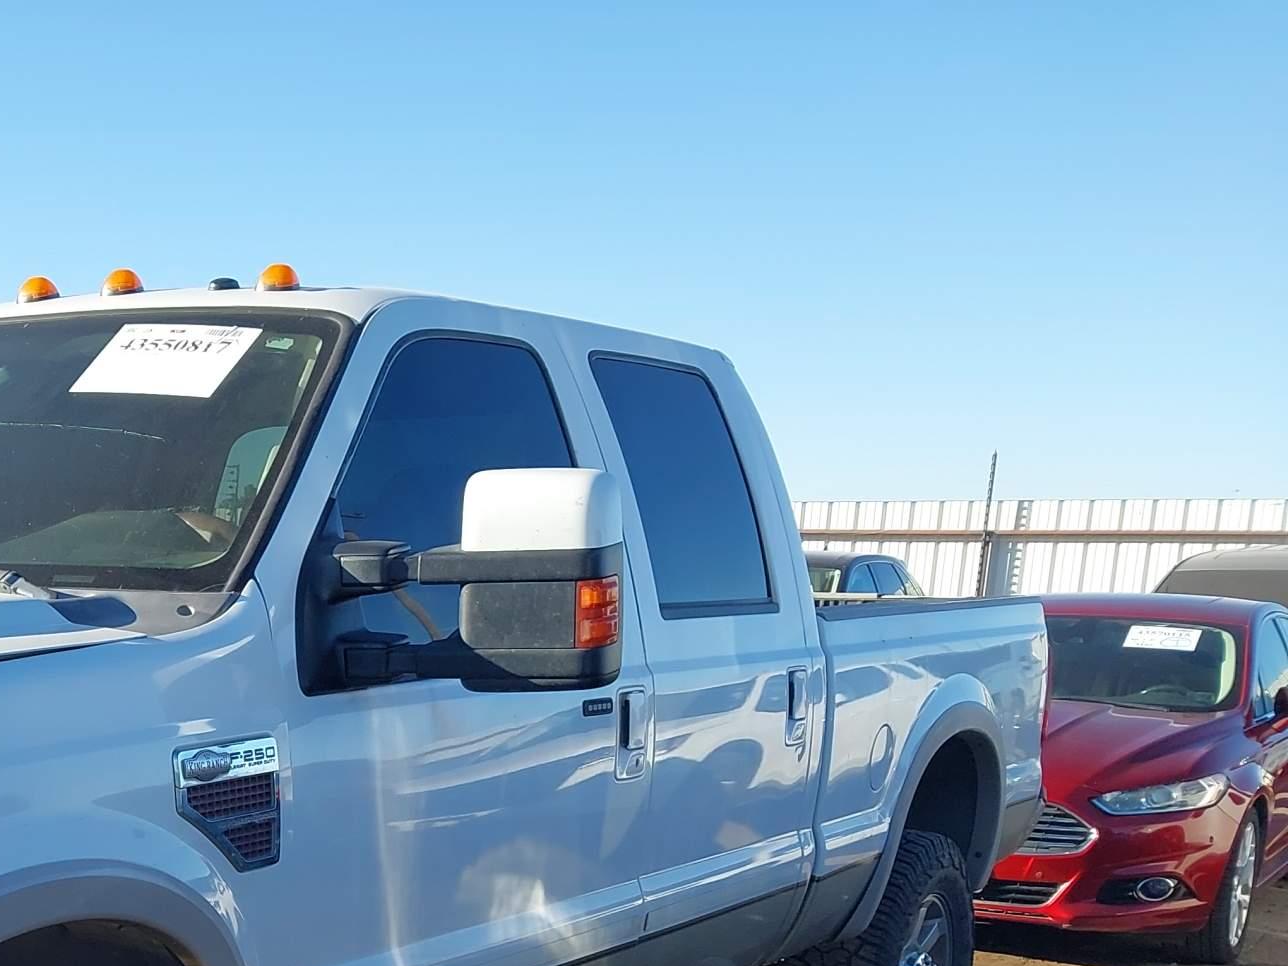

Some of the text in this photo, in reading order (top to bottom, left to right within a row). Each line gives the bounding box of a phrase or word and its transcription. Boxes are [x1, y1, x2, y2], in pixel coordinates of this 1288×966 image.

[120, 338, 233, 354] 43550817
[230, 746, 276, 763] F-250
[188, 757, 228, 771] KING RANCH
